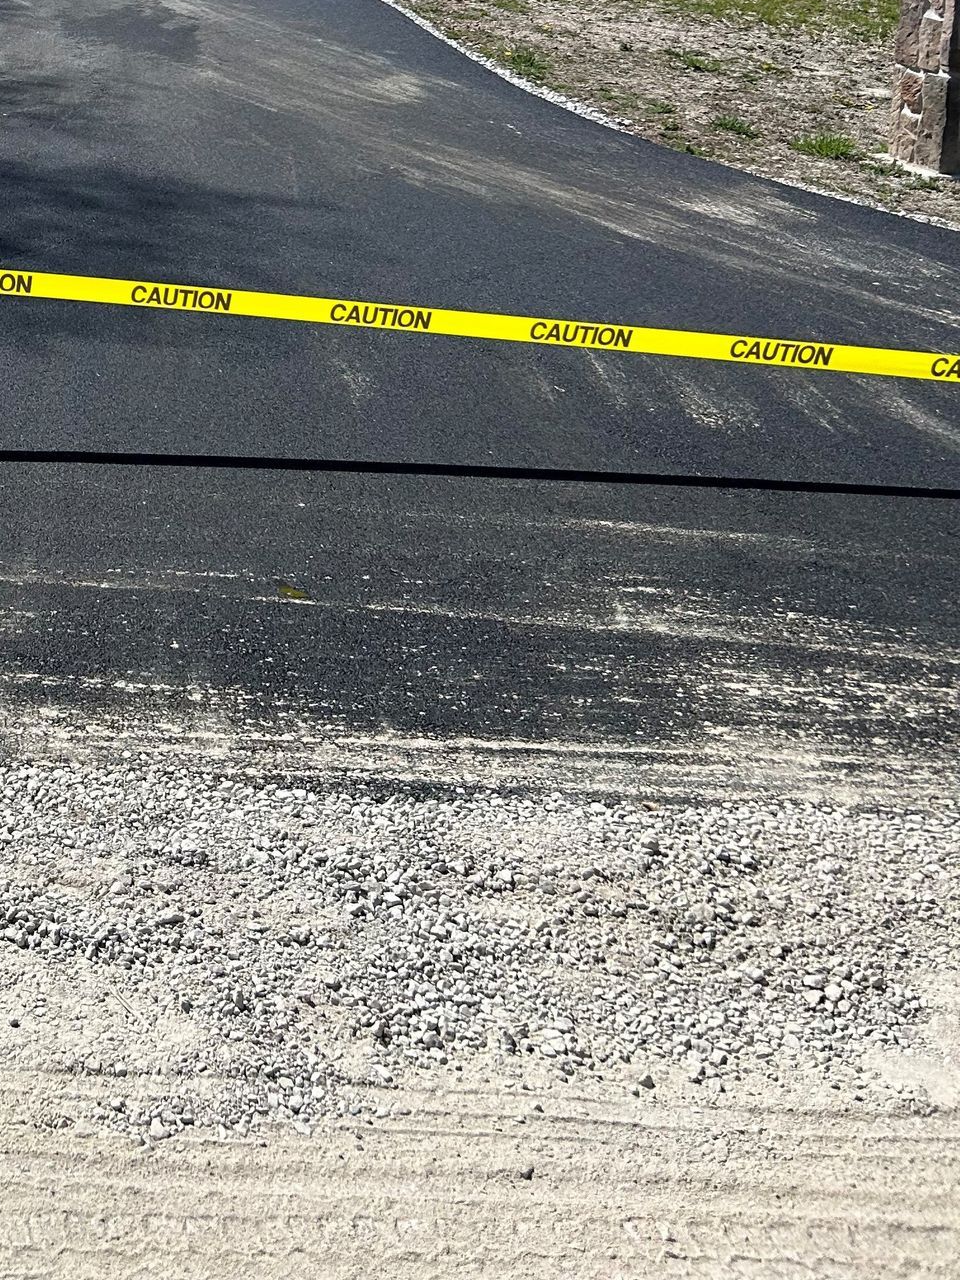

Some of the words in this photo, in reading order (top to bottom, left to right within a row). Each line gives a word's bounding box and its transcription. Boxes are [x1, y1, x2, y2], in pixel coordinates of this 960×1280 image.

[131, 285, 232, 311] CAUTION
[330, 303, 432, 329] CAUTION
[530, 321, 634, 347] CAUTION
[730, 339, 834, 366] CAUTION
